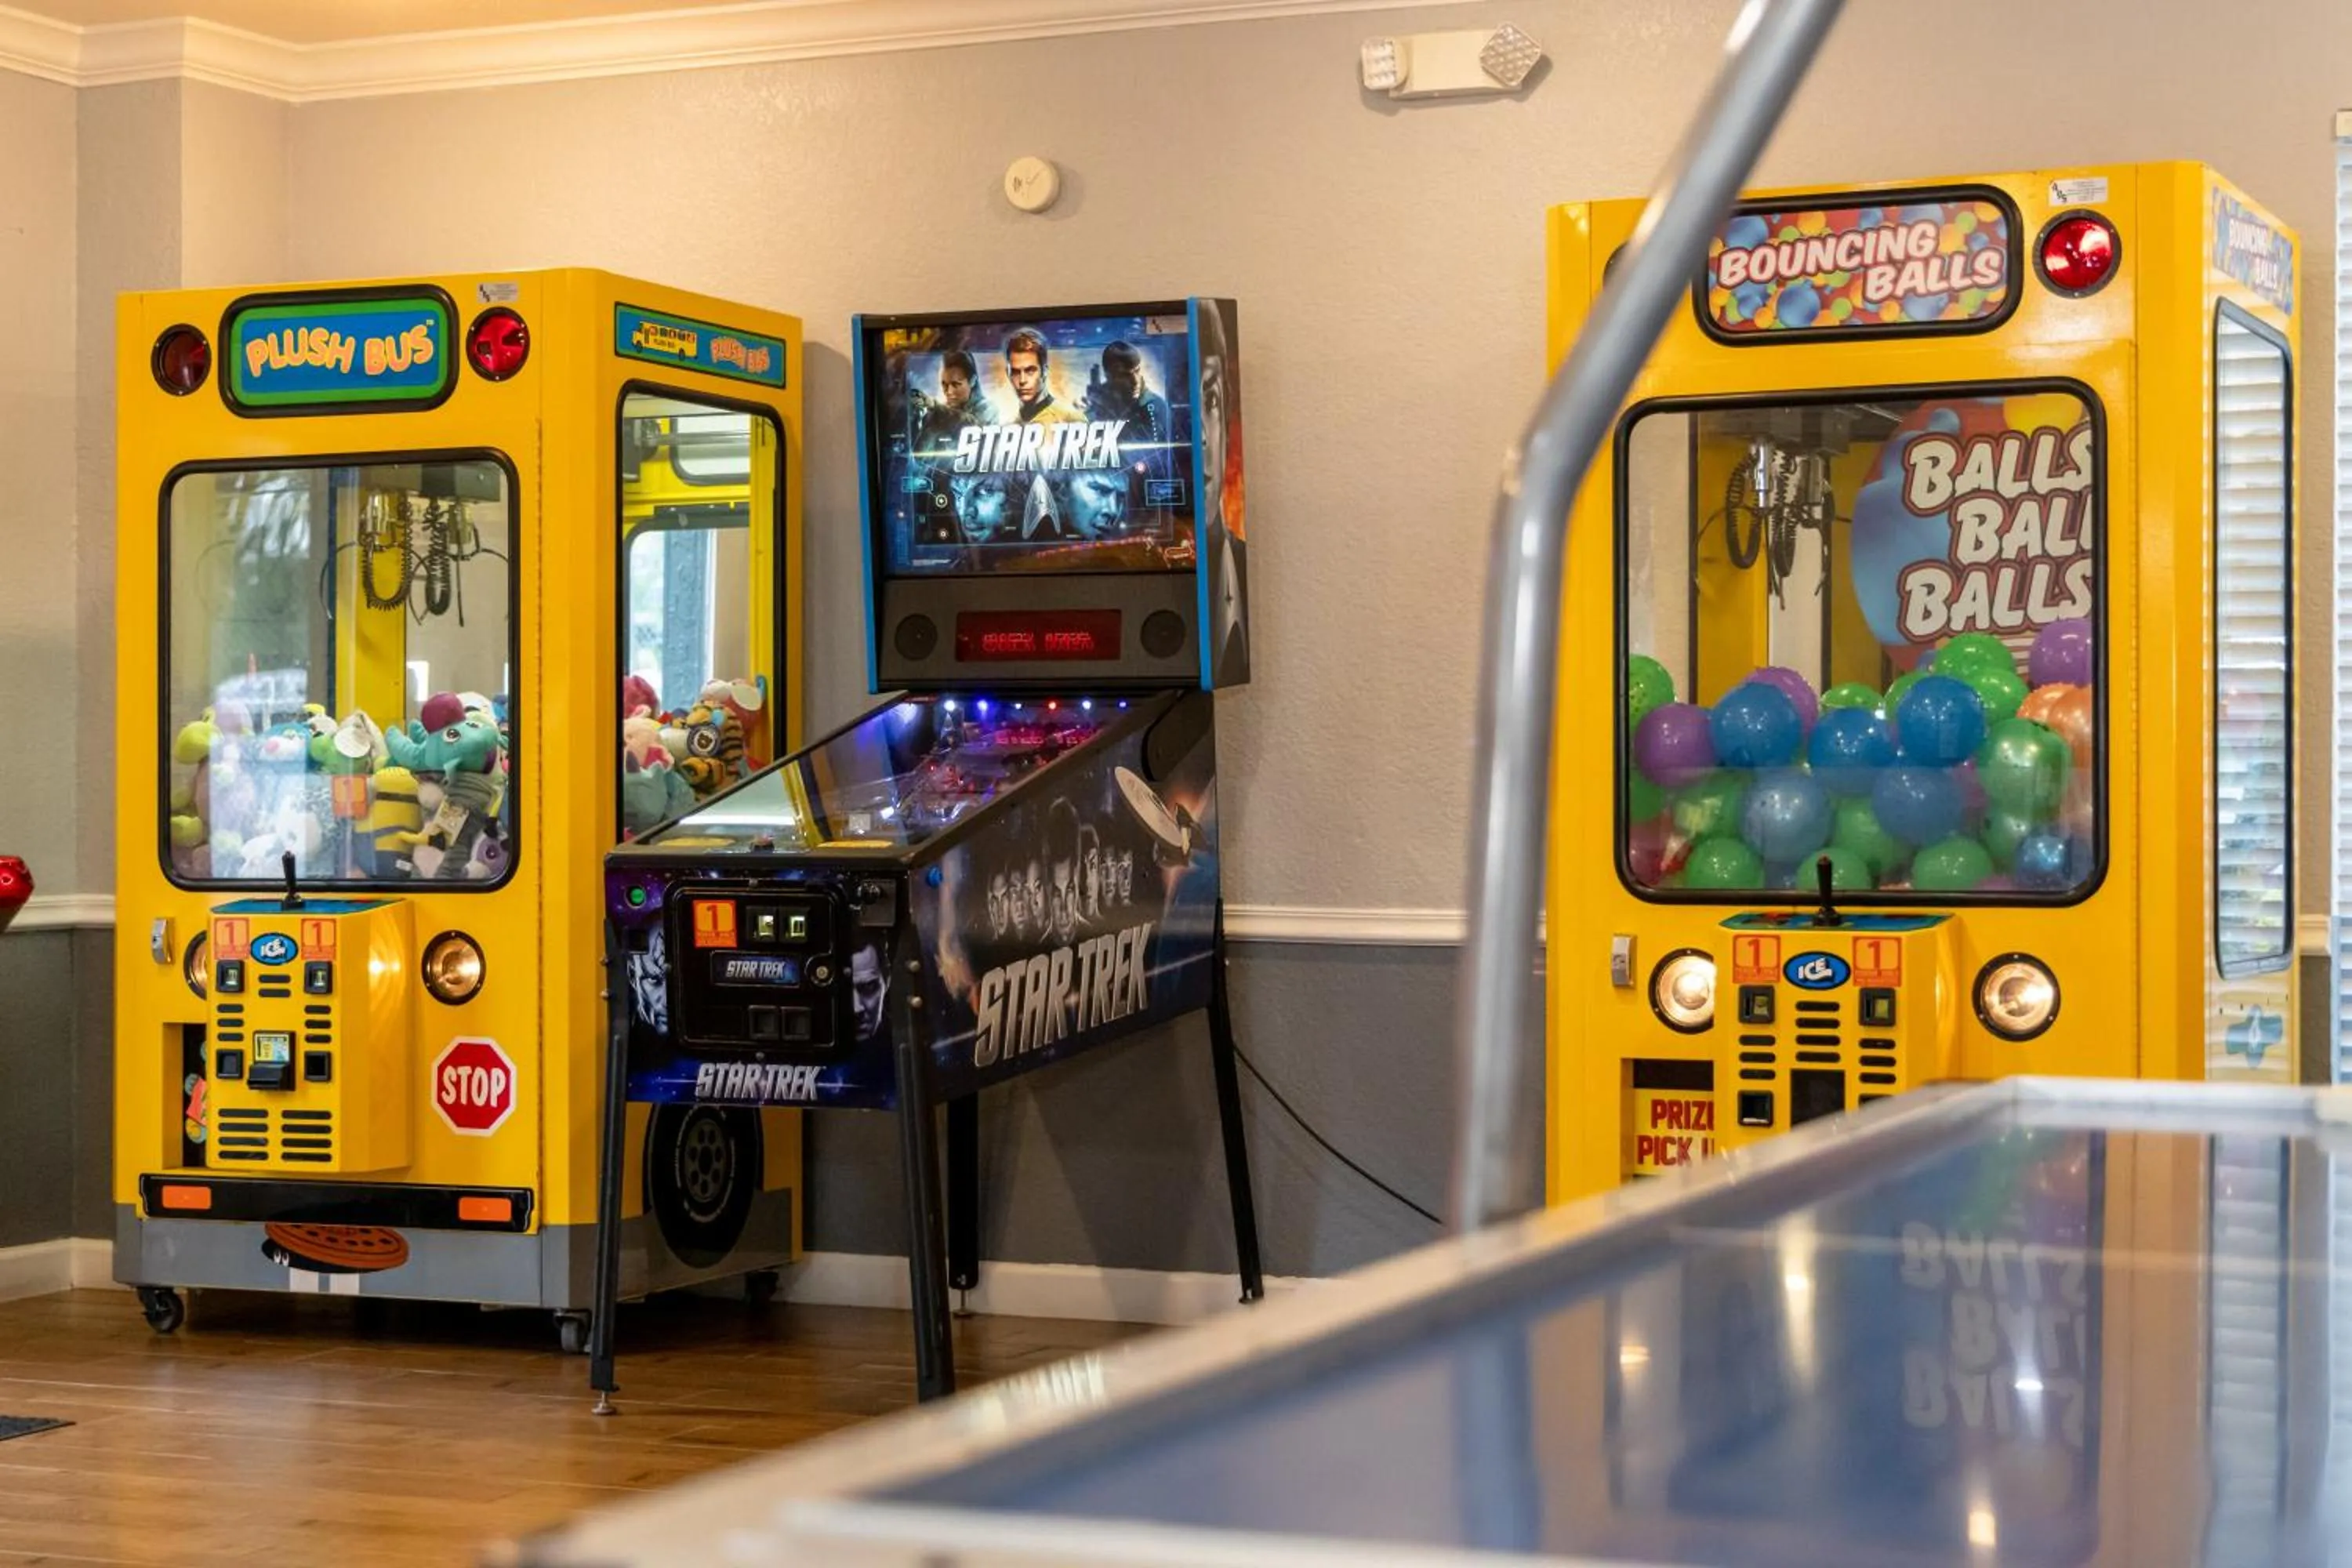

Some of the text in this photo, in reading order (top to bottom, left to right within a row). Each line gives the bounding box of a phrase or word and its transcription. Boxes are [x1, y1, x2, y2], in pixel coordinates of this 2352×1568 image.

[1719, 221, 1938, 287] BOUNCING
[1864, 249, 2003, 303] BALLS
[245, 324, 434, 378] PLUSH BUS
[710, 336, 771, 374] PLUSH BUS
[953, 419, 1127, 473] STAR TREK
[1908, 430, 2092, 510] BALLS
[1904, 557, 2092, 637] BALLS
[224, 921, 235, 951] 1
[312, 921, 322, 952] 1
[706, 904, 720, 938] 1
[726, 960, 785, 978] STAR TREK
[1748, 938, 1762, 975] 1
[1798, 956, 1832, 981] ICE
[1867, 940, 1882, 976] 1
[975, 922, 1152, 1067] STAR TREK
[441, 1065, 506, 1108] STOP
[695, 1062, 820, 1101] STAR TREK
[1637, 1134, 1693, 1167] PICK
